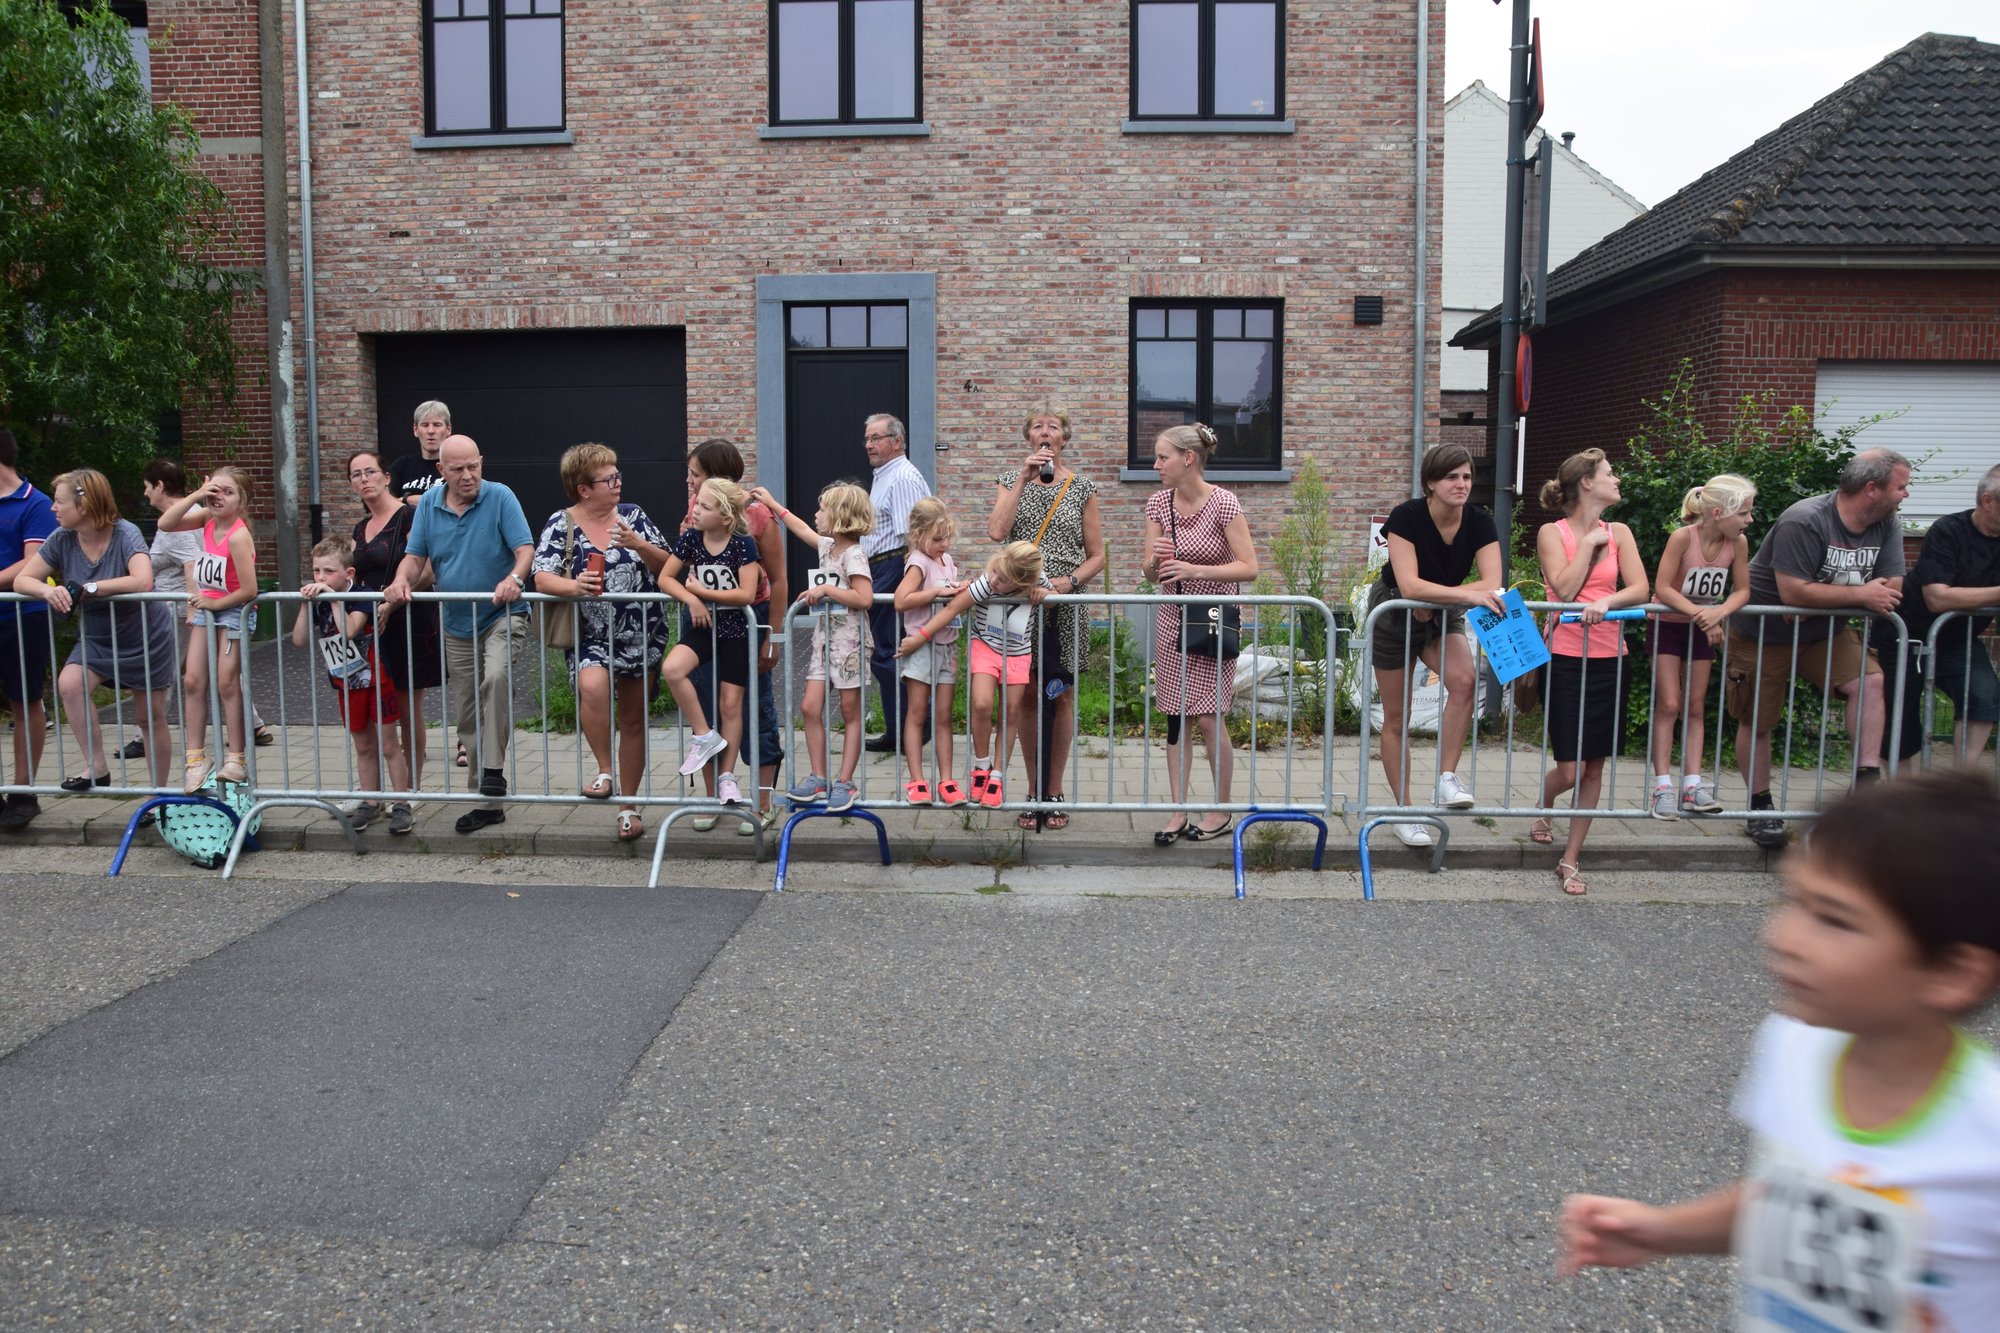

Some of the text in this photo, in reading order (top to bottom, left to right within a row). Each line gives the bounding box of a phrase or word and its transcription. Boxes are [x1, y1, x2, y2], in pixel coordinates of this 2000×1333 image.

[197, 557, 223, 587] 104
[703, 568, 737, 590] 93
[1688, 571, 1723, 597] 166
